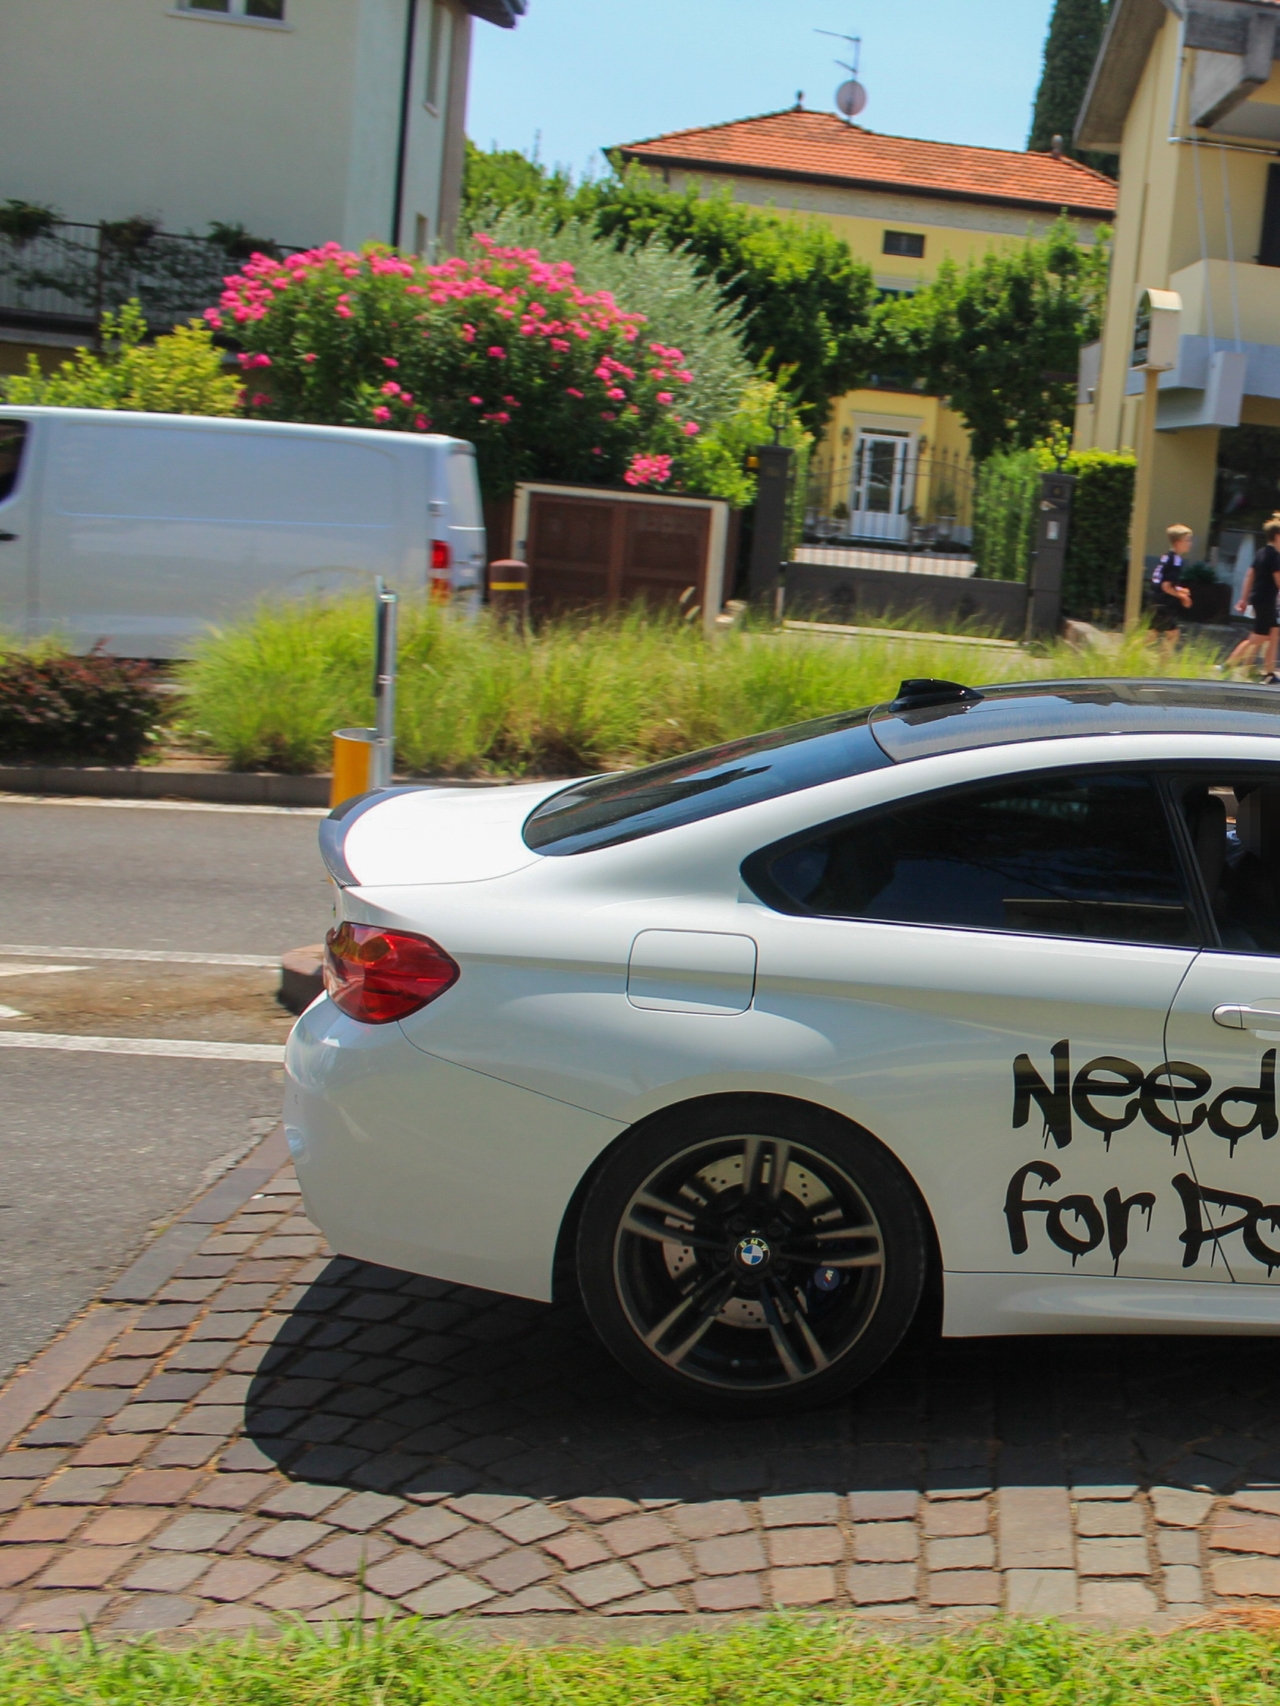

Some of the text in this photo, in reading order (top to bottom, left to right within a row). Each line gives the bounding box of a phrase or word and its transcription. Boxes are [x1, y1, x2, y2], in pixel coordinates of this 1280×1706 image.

[1012, 1039, 1279, 1158] Need
[739, 1238, 769, 1251] BMW
[1003, 1160, 1156, 1277] for
